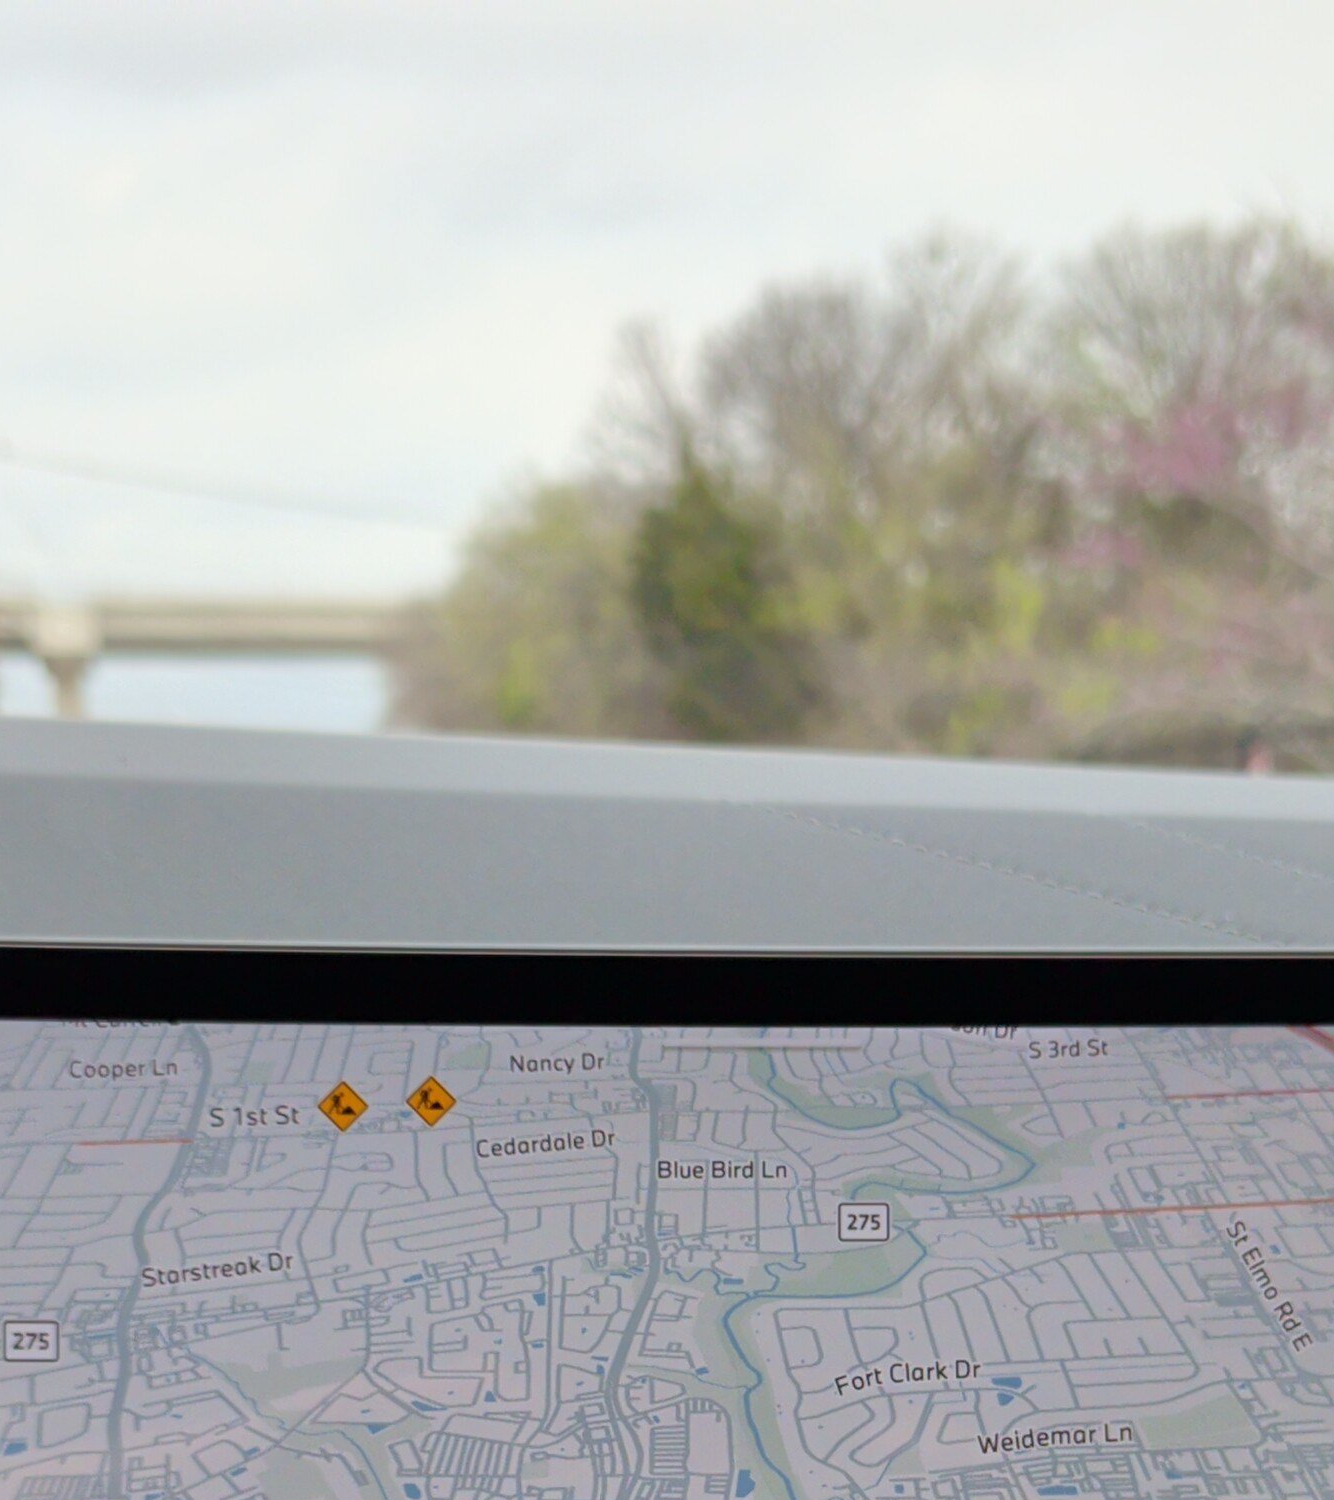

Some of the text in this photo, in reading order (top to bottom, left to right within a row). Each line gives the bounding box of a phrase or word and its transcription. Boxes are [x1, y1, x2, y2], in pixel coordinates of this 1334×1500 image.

[1029, 1039, 1108, 1059] S 3rd St
[69, 1059, 178, 1080] Cooper Ln
[510, 1053, 604, 1075] Nancy Dr
[209, 1105, 300, 1127] S 1st St
[476, 1130, 615, 1158] Cedardale Dr
[657, 1160, 787, 1180] Blue Bird Ln
[846, 1213, 880, 1231] 275
[141, 1253, 294, 1287] Starstreak Dr
[1226, 1220, 1313, 1352] St Elmo Rd E
[13, 1333, 49, 1350] 275
[834, 1359, 981, 1396] Fort Clark Dr
[977, 1422, 1133, 1453] Weidemar Ln
